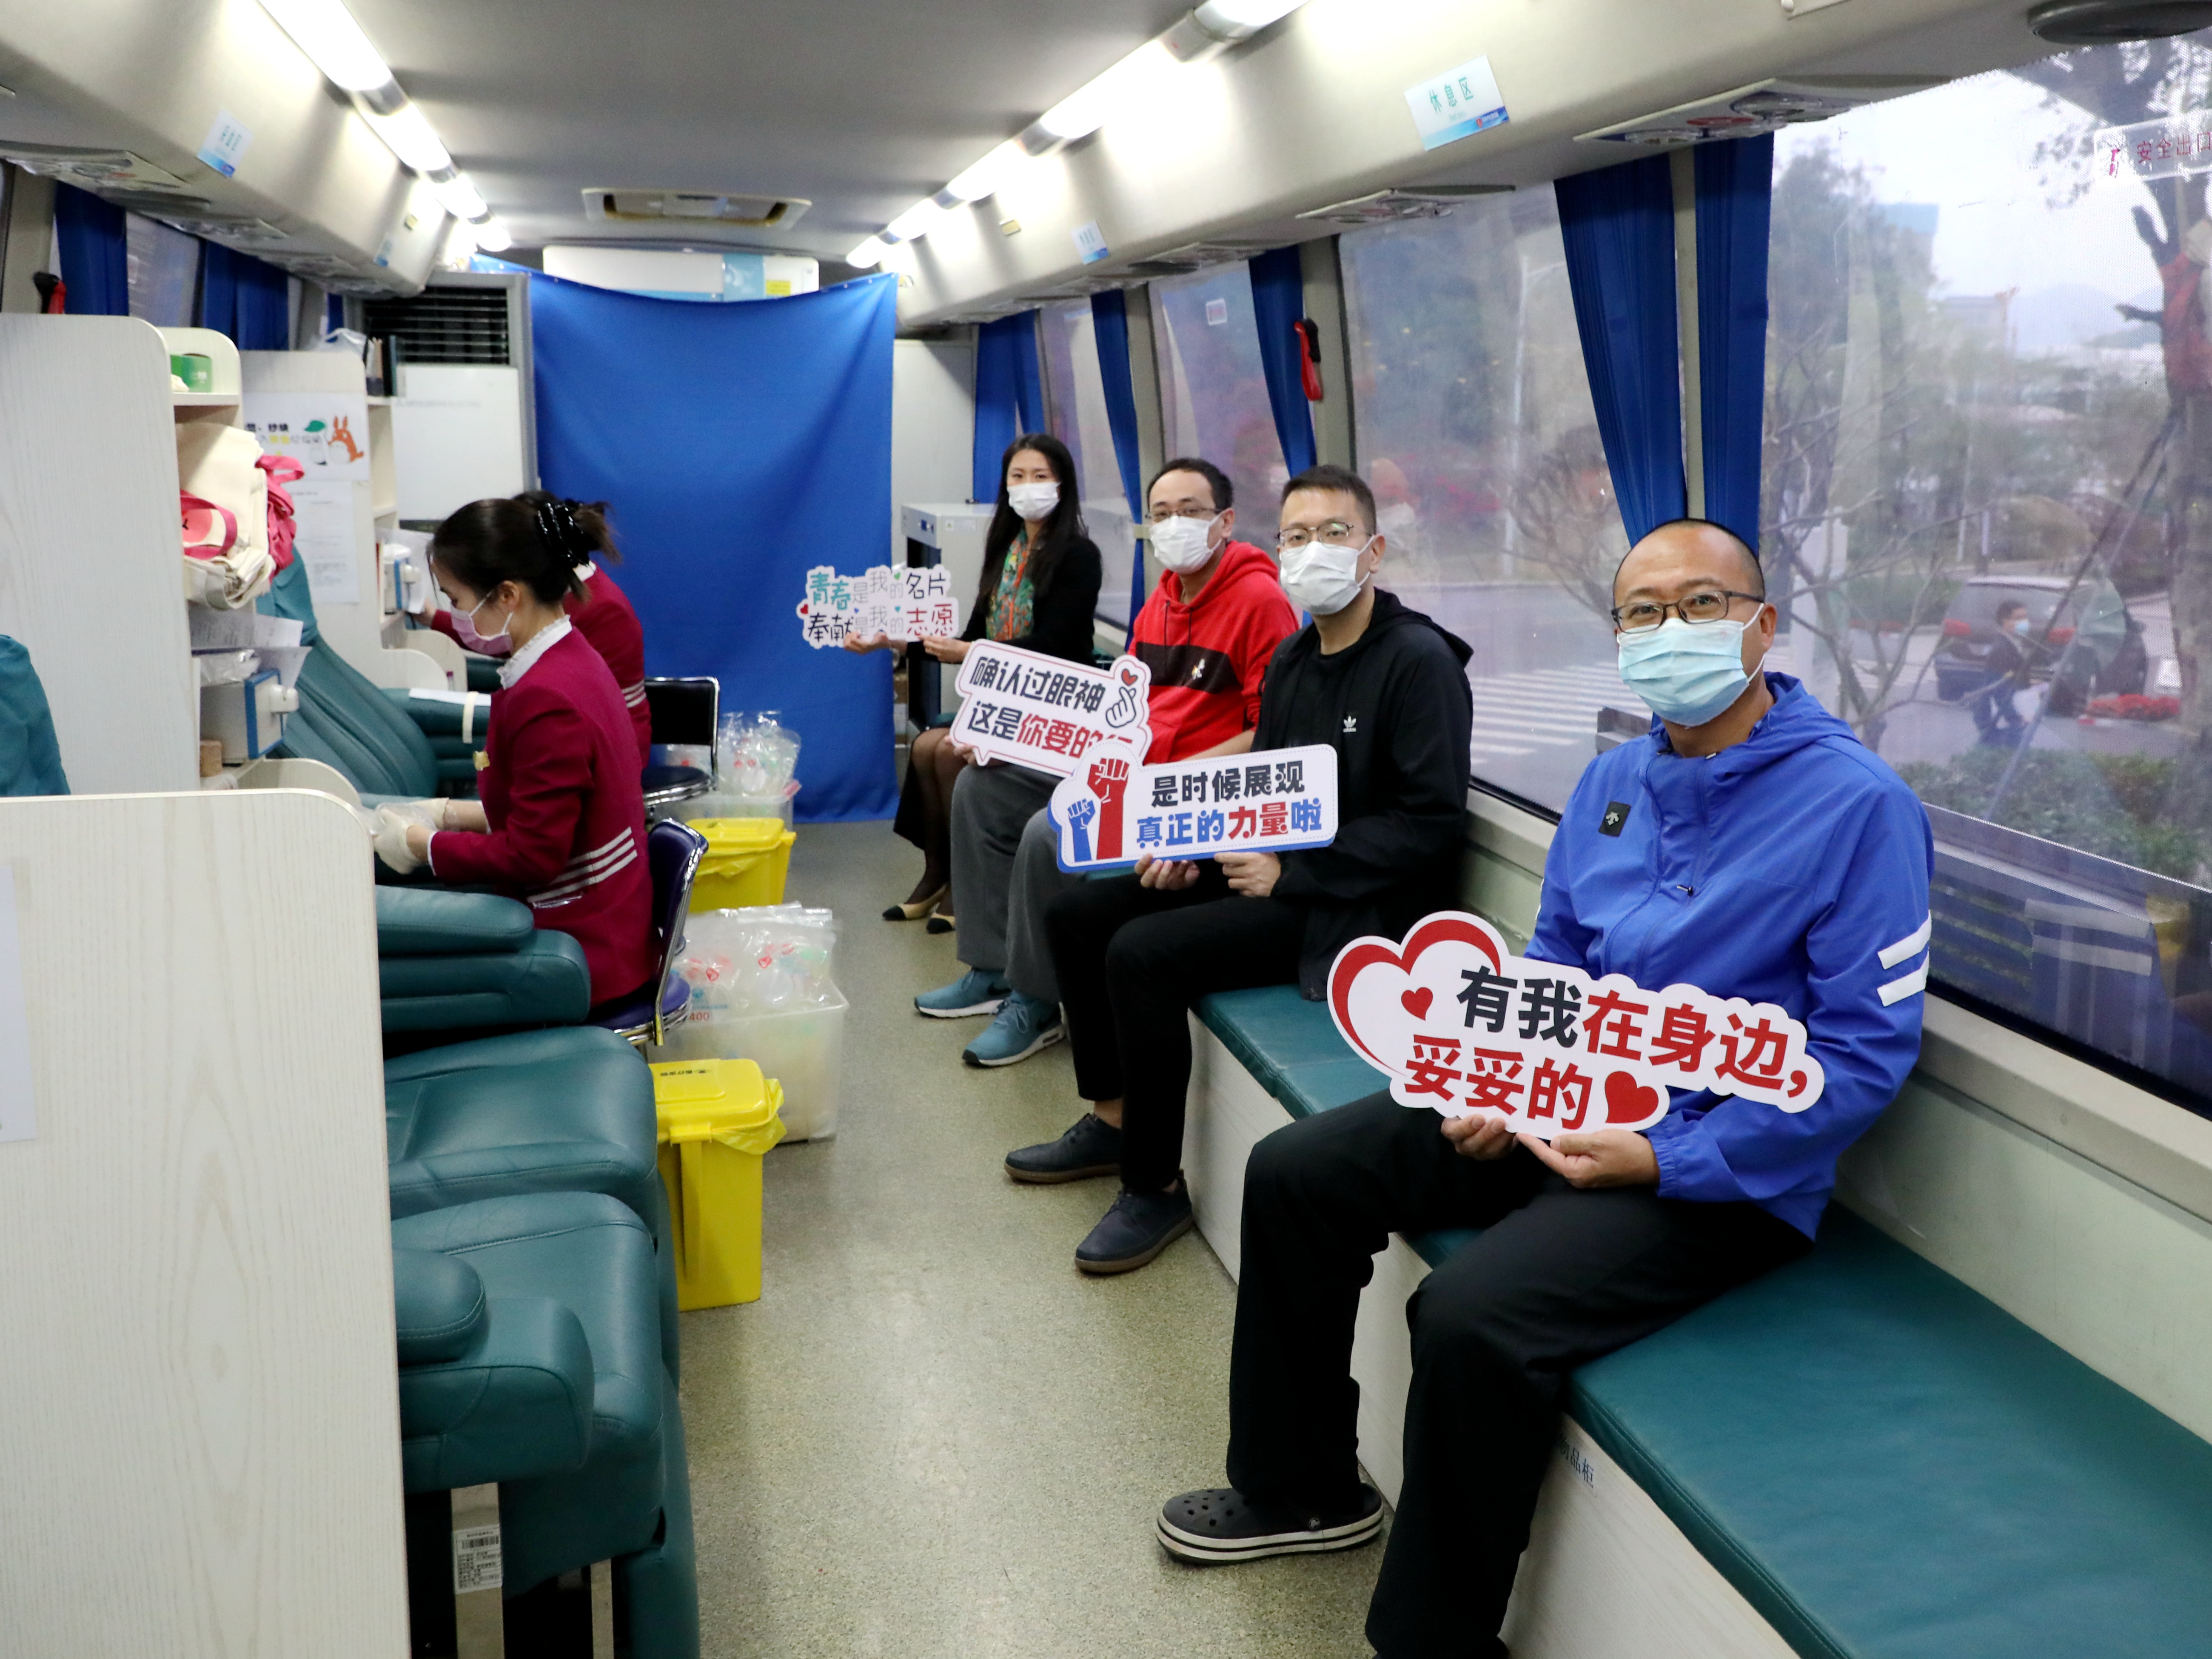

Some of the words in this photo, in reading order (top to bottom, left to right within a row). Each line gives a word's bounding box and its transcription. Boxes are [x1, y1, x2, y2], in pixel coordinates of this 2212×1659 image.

[1429, 77, 1474, 114] 休息区
[2137, 131, 2211, 163] 安全出口
[810, 570, 946, 610] 青春是我的名片
[809, 603, 953, 642] 奉献是我的志愿
[969, 656, 1106, 713] 确认过眼神
[968, 701, 1133, 759] 这是你要的
[1151, 760, 1305, 808] 是时候展现
[1137, 797, 1322, 849] 真正的力量啦
[1404, 1034, 1593, 1130] 妥妥的
